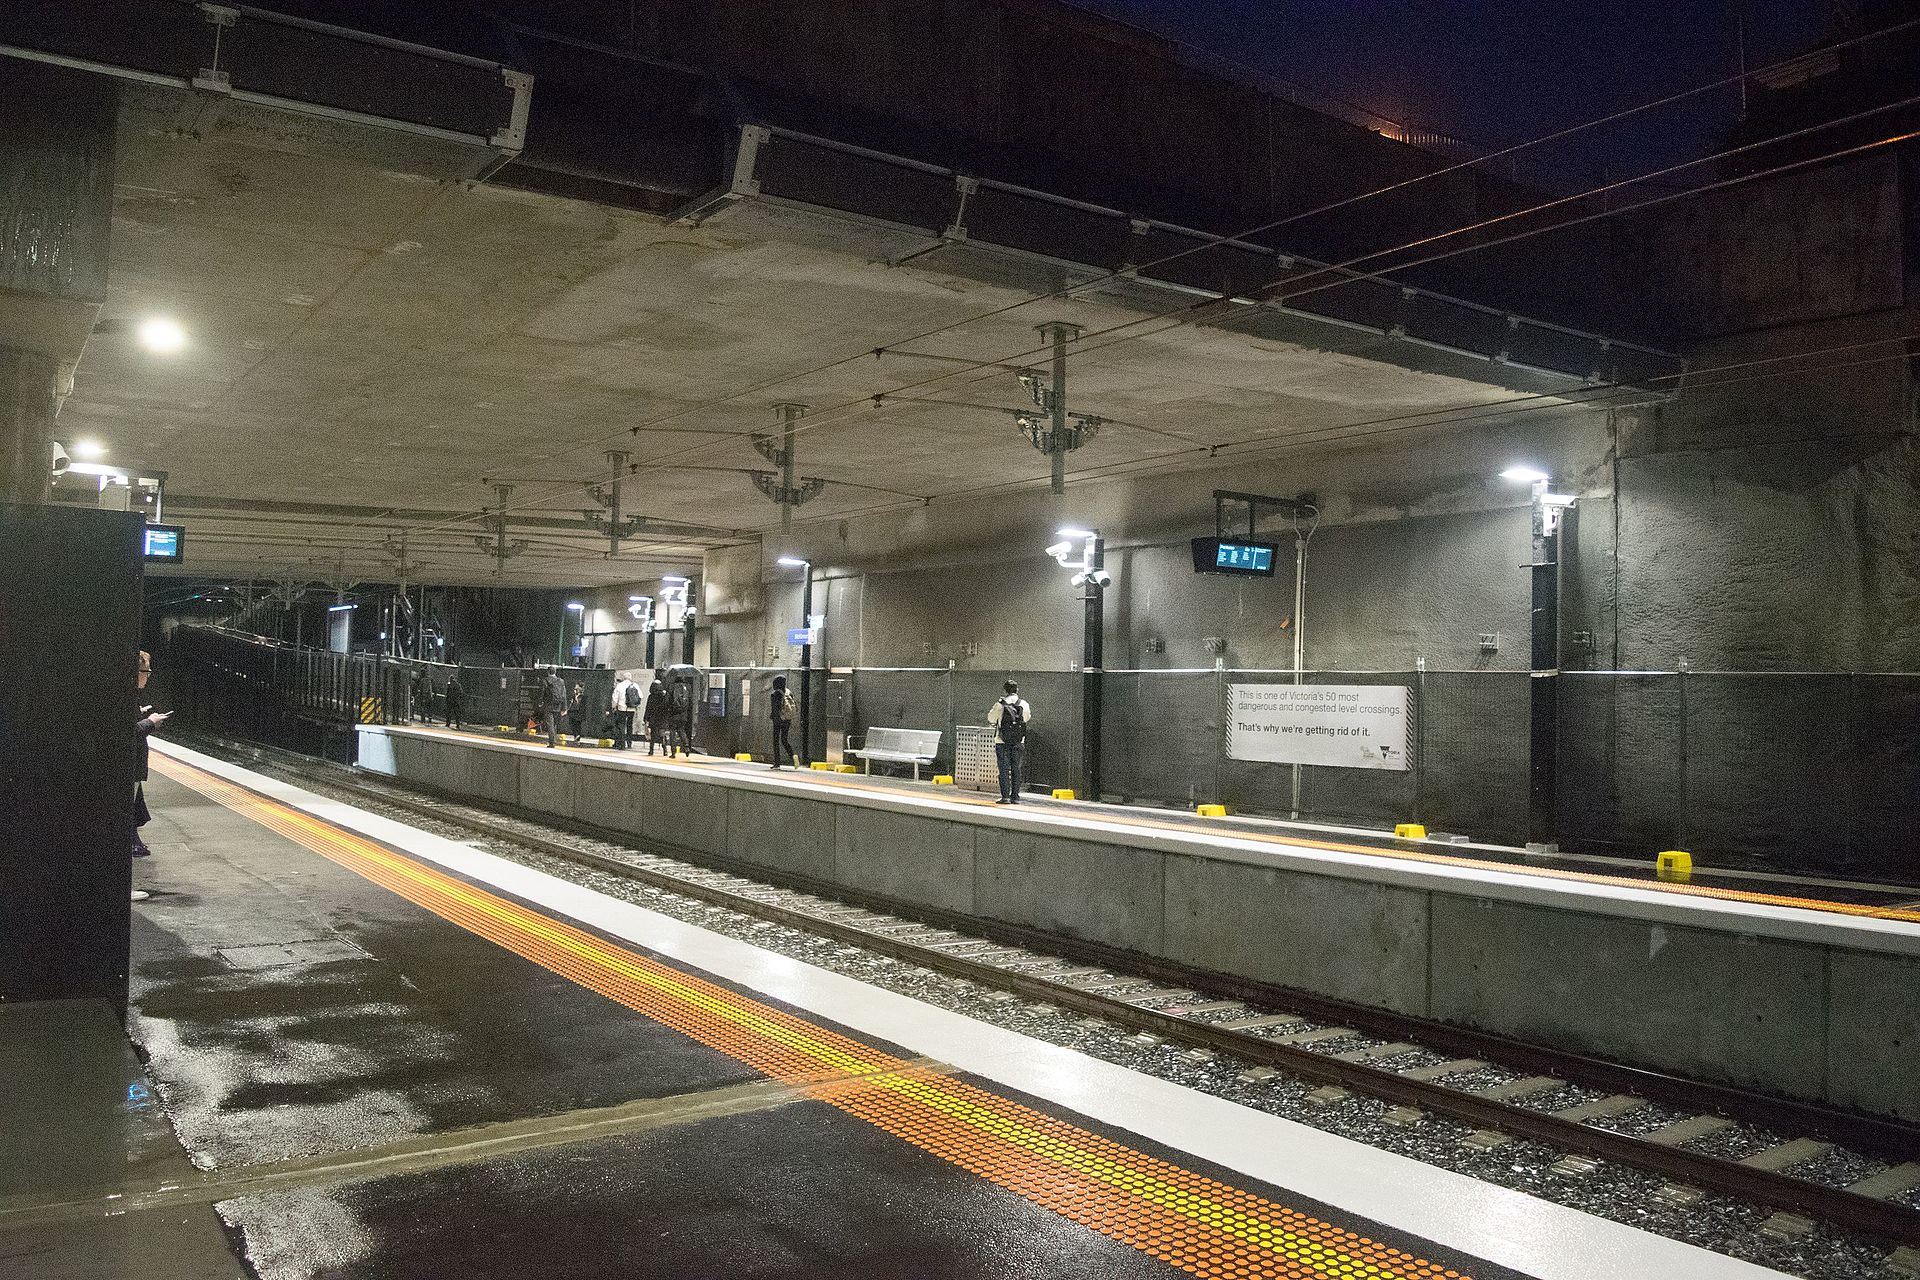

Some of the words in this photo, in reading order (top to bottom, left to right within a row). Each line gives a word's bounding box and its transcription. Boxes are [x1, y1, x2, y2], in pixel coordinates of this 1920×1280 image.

[1238, 690, 1254, 699] This
[1256, 691, 1262, 700] is
[1264, 692, 1278, 700] one
[1280, 691, 1288, 700] of
[1289, 691, 1324, 701] Victoria's
[1326, 692, 1336, 701] 50
[1338, 693, 1359, 702] most
[1238, 701, 1278, 712] dangerous
[1278, 702, 1294, 711] and
[1294, 703, 1336, 714] congested
[1338, 704, 1358, 713] level
[1359, 705, 1402, 716] crossings.
[1238, 722, 1261, 732] That's
[1263, 724, 1280, 734] why
[1282, 724, 1304, 734] we're
[1305, 726, 1334, 737] getting
[1337, 727, 1348, 736] rid
[1350, 727, 1360, 736] of
[1362, 727, 1370, 736] it.
